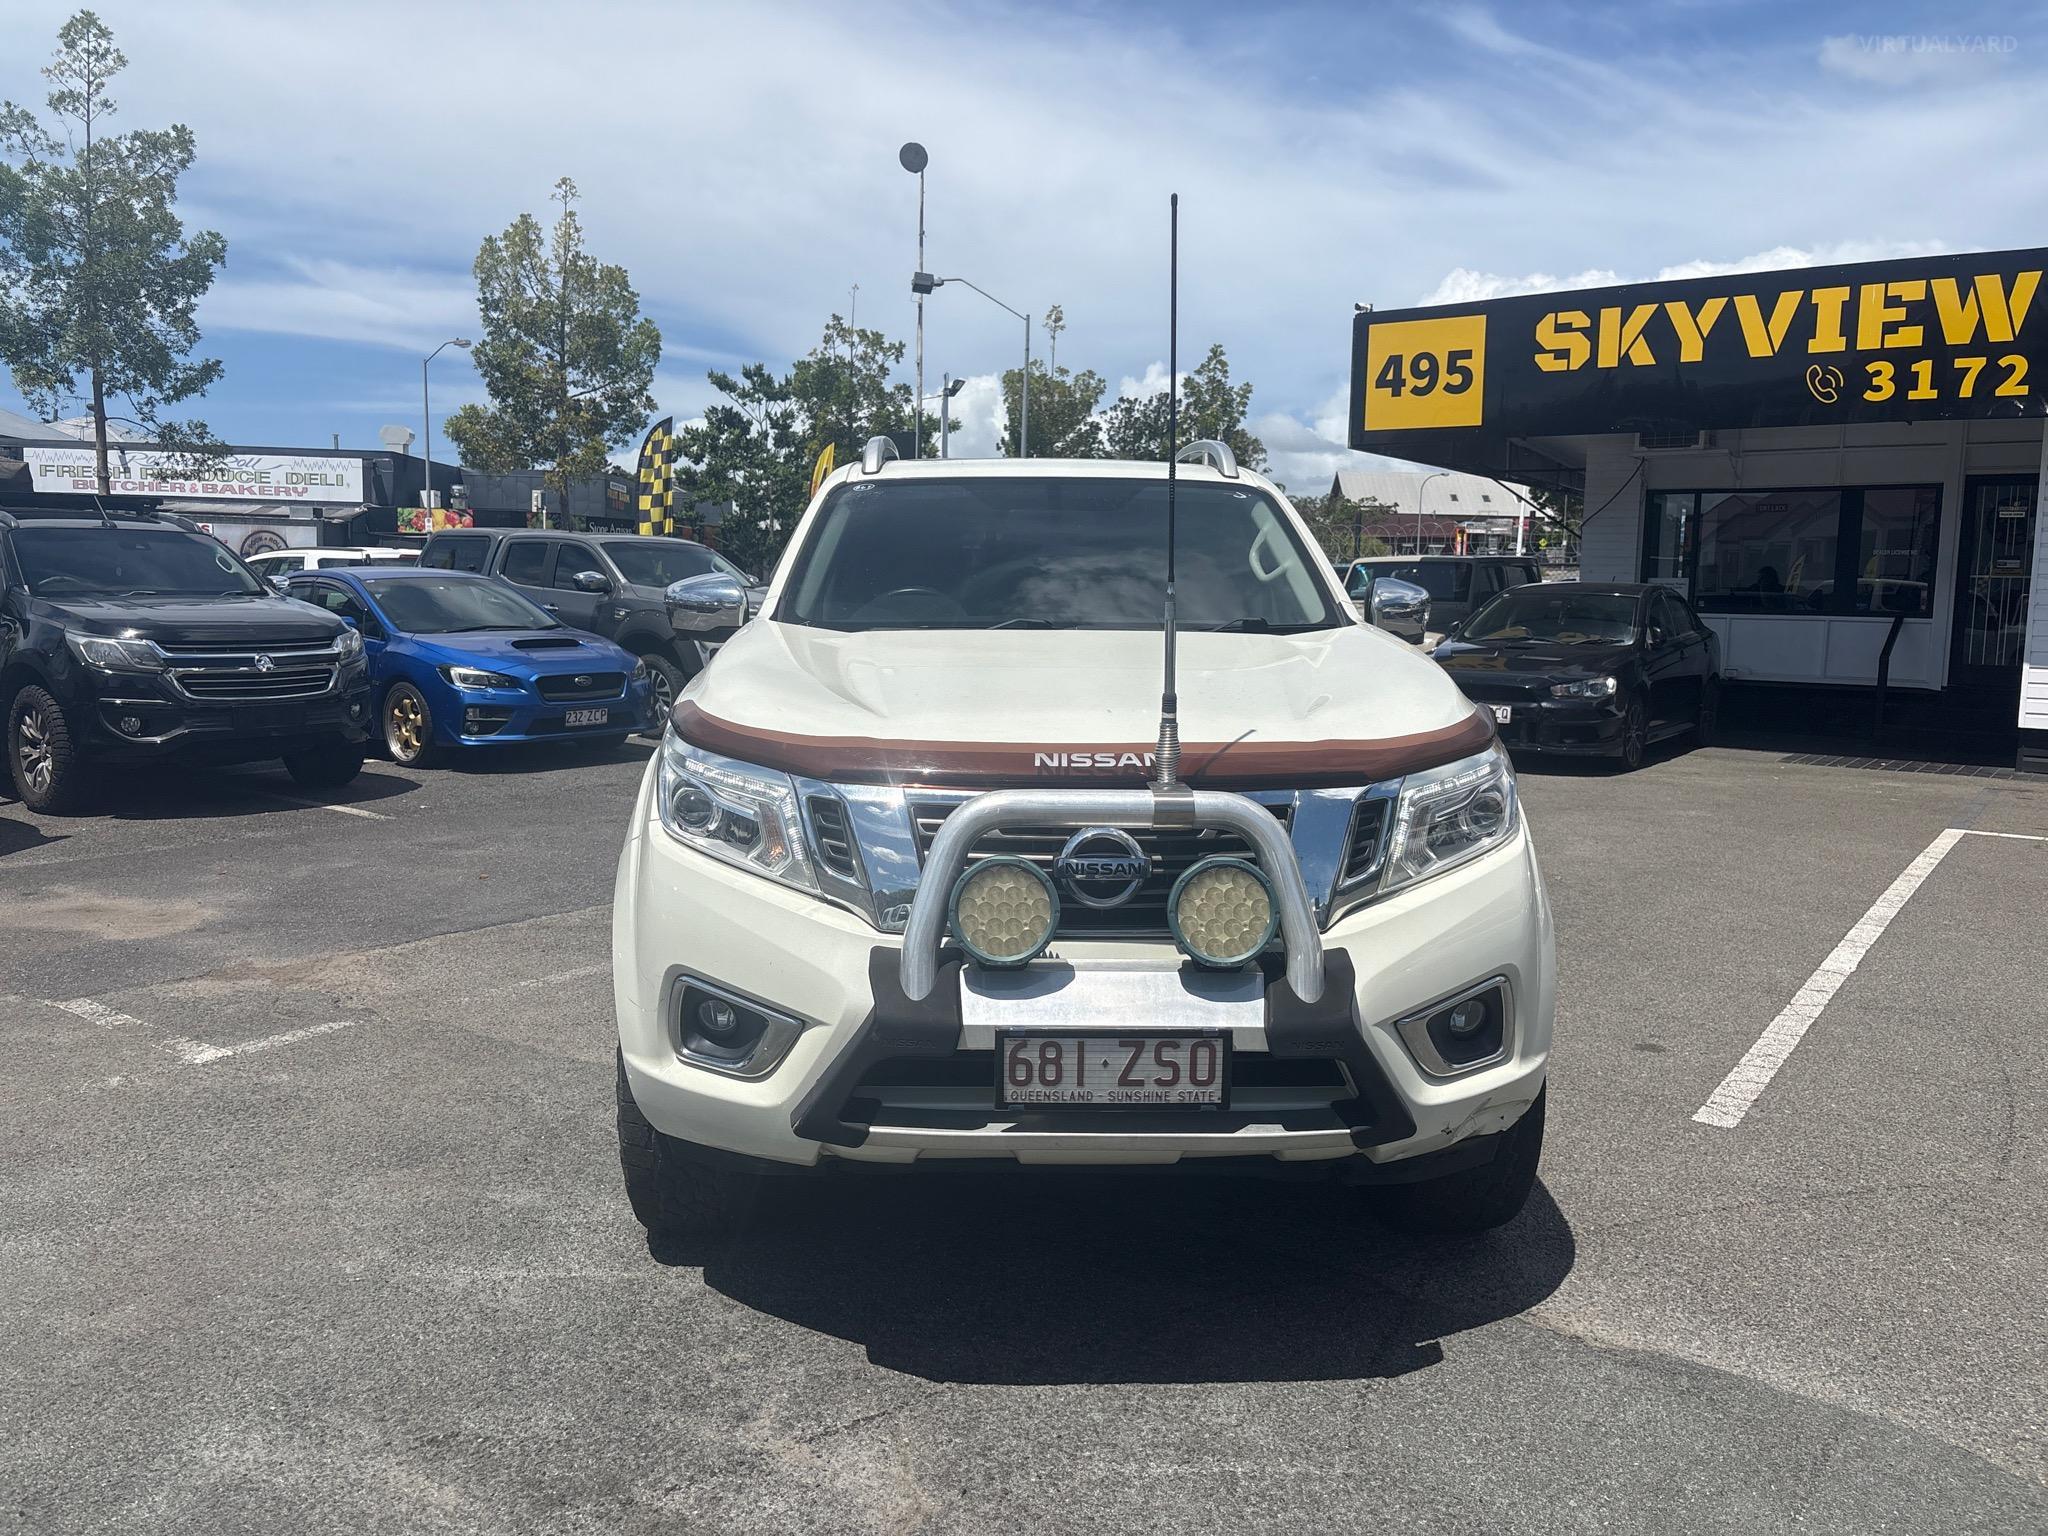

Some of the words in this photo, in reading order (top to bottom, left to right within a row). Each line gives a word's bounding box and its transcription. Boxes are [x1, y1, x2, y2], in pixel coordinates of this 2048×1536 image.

[1535, 271, 2043, 372] SKYVIEW
[1375, 349, 1473, 397] 495
[1863, 354, 2030, 402] 3172
[202, 483, 308, 497] BAKERY
[566, 711, 583, 724] 232
[1065, 862, 1141, 876] NISSAN
[1008, 1040, 1085, 1087] 681
[1117, 1040, 1217, 1087] ZSO
[1010, 1090, 1094, 1102] QUEENSLAND
[1108, 1090, 1171, 1102] SUNSHINE
[1178, 1090, 1215, 1102] STATE
